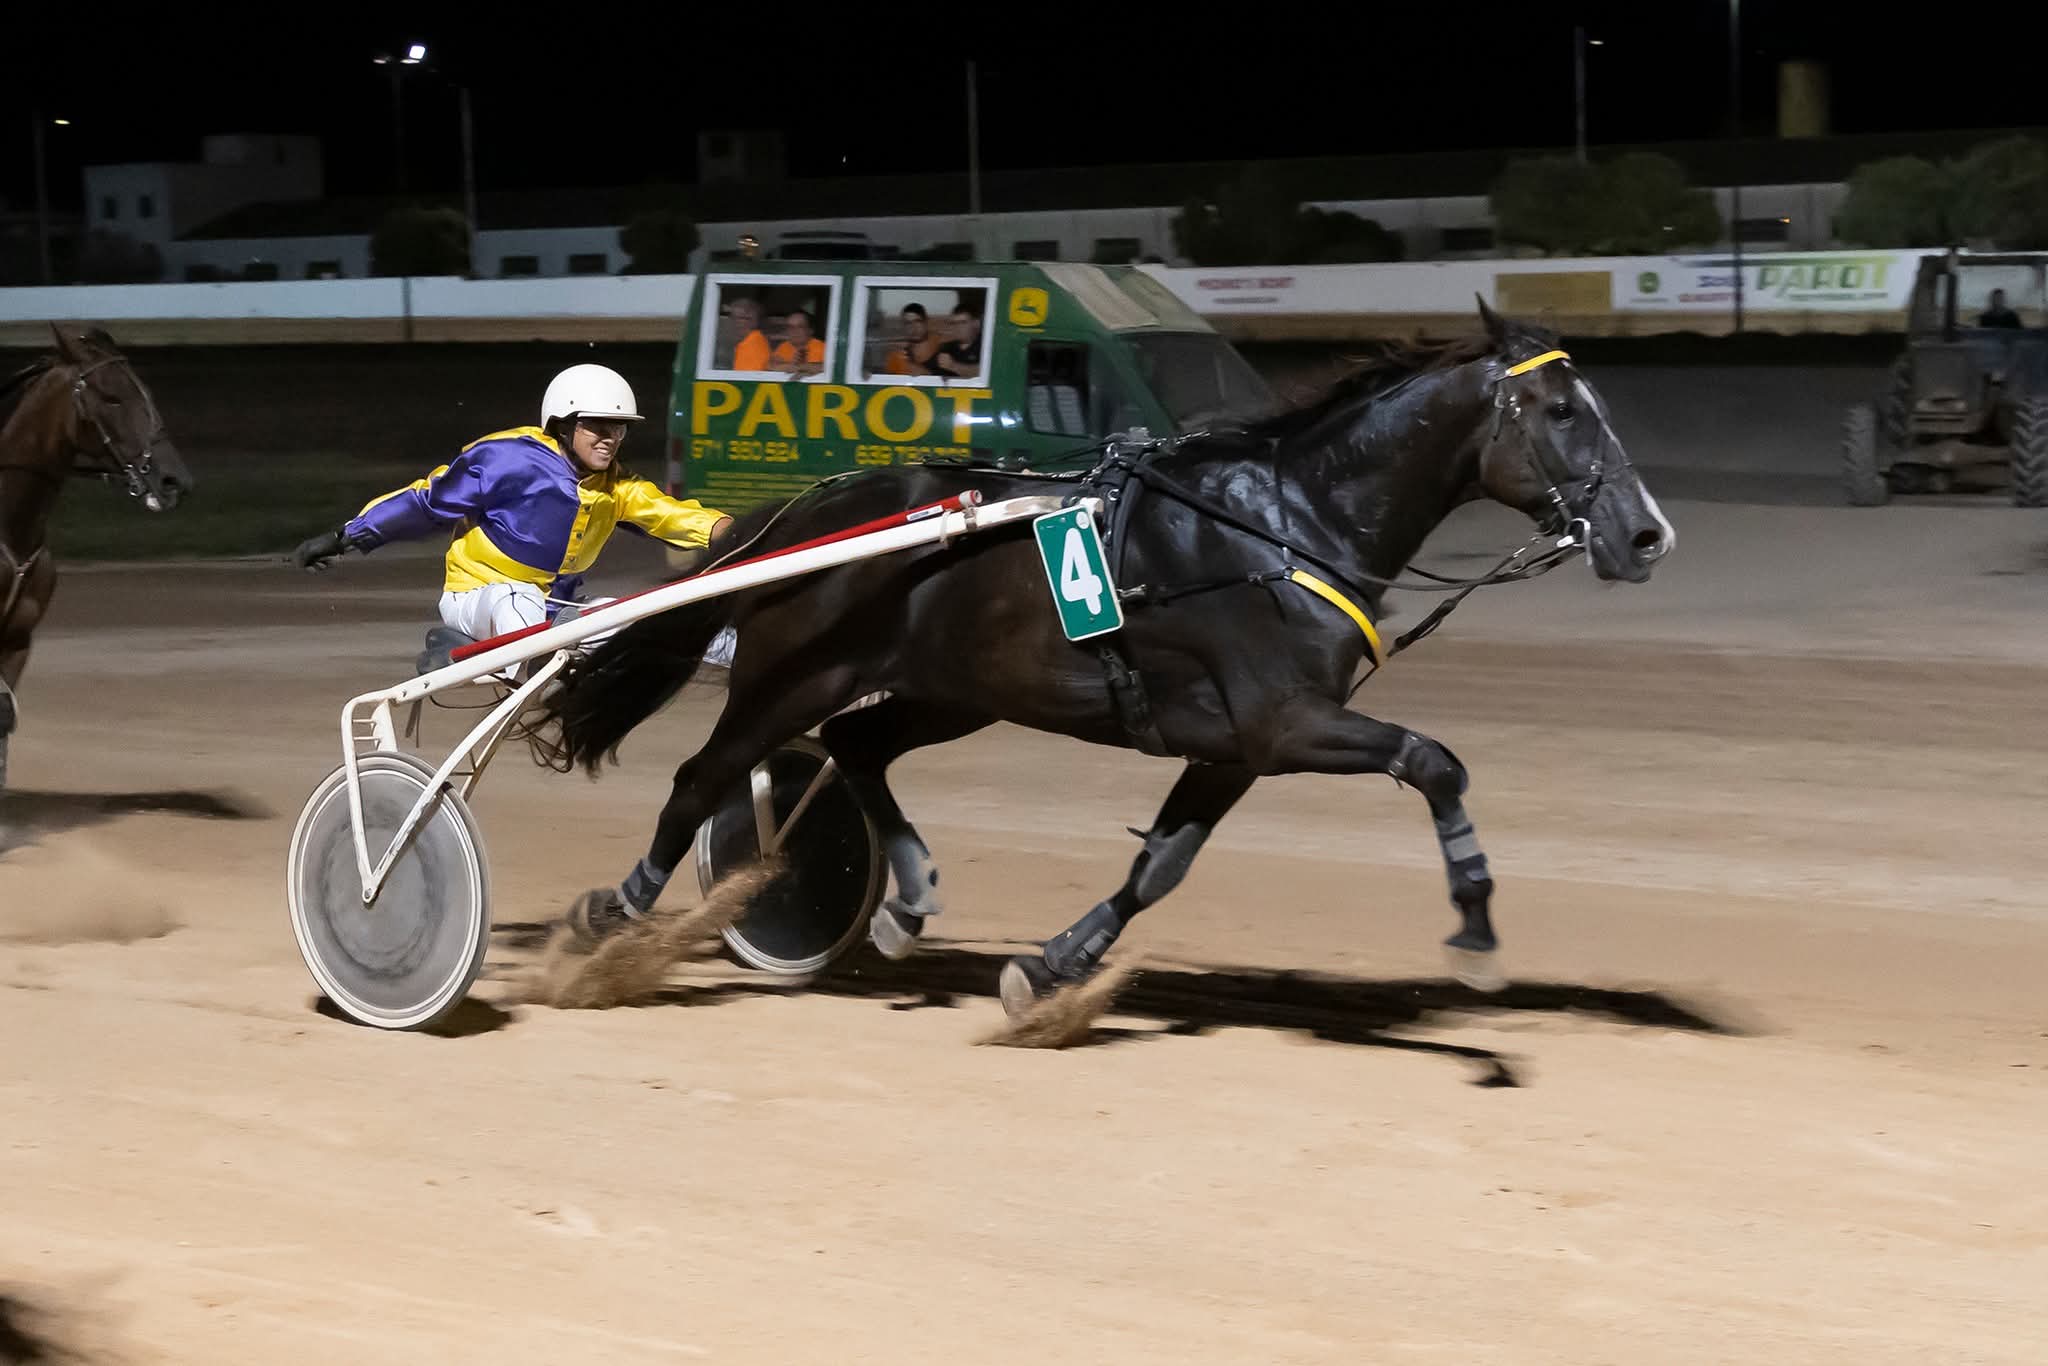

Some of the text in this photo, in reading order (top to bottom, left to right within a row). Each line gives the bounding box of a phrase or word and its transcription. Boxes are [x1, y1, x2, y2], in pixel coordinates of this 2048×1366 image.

[1757, 256, 1896, 294] PAROT
[692, 382, 992, 444] PAROT
[1061, 528, 1103, 615] 4
